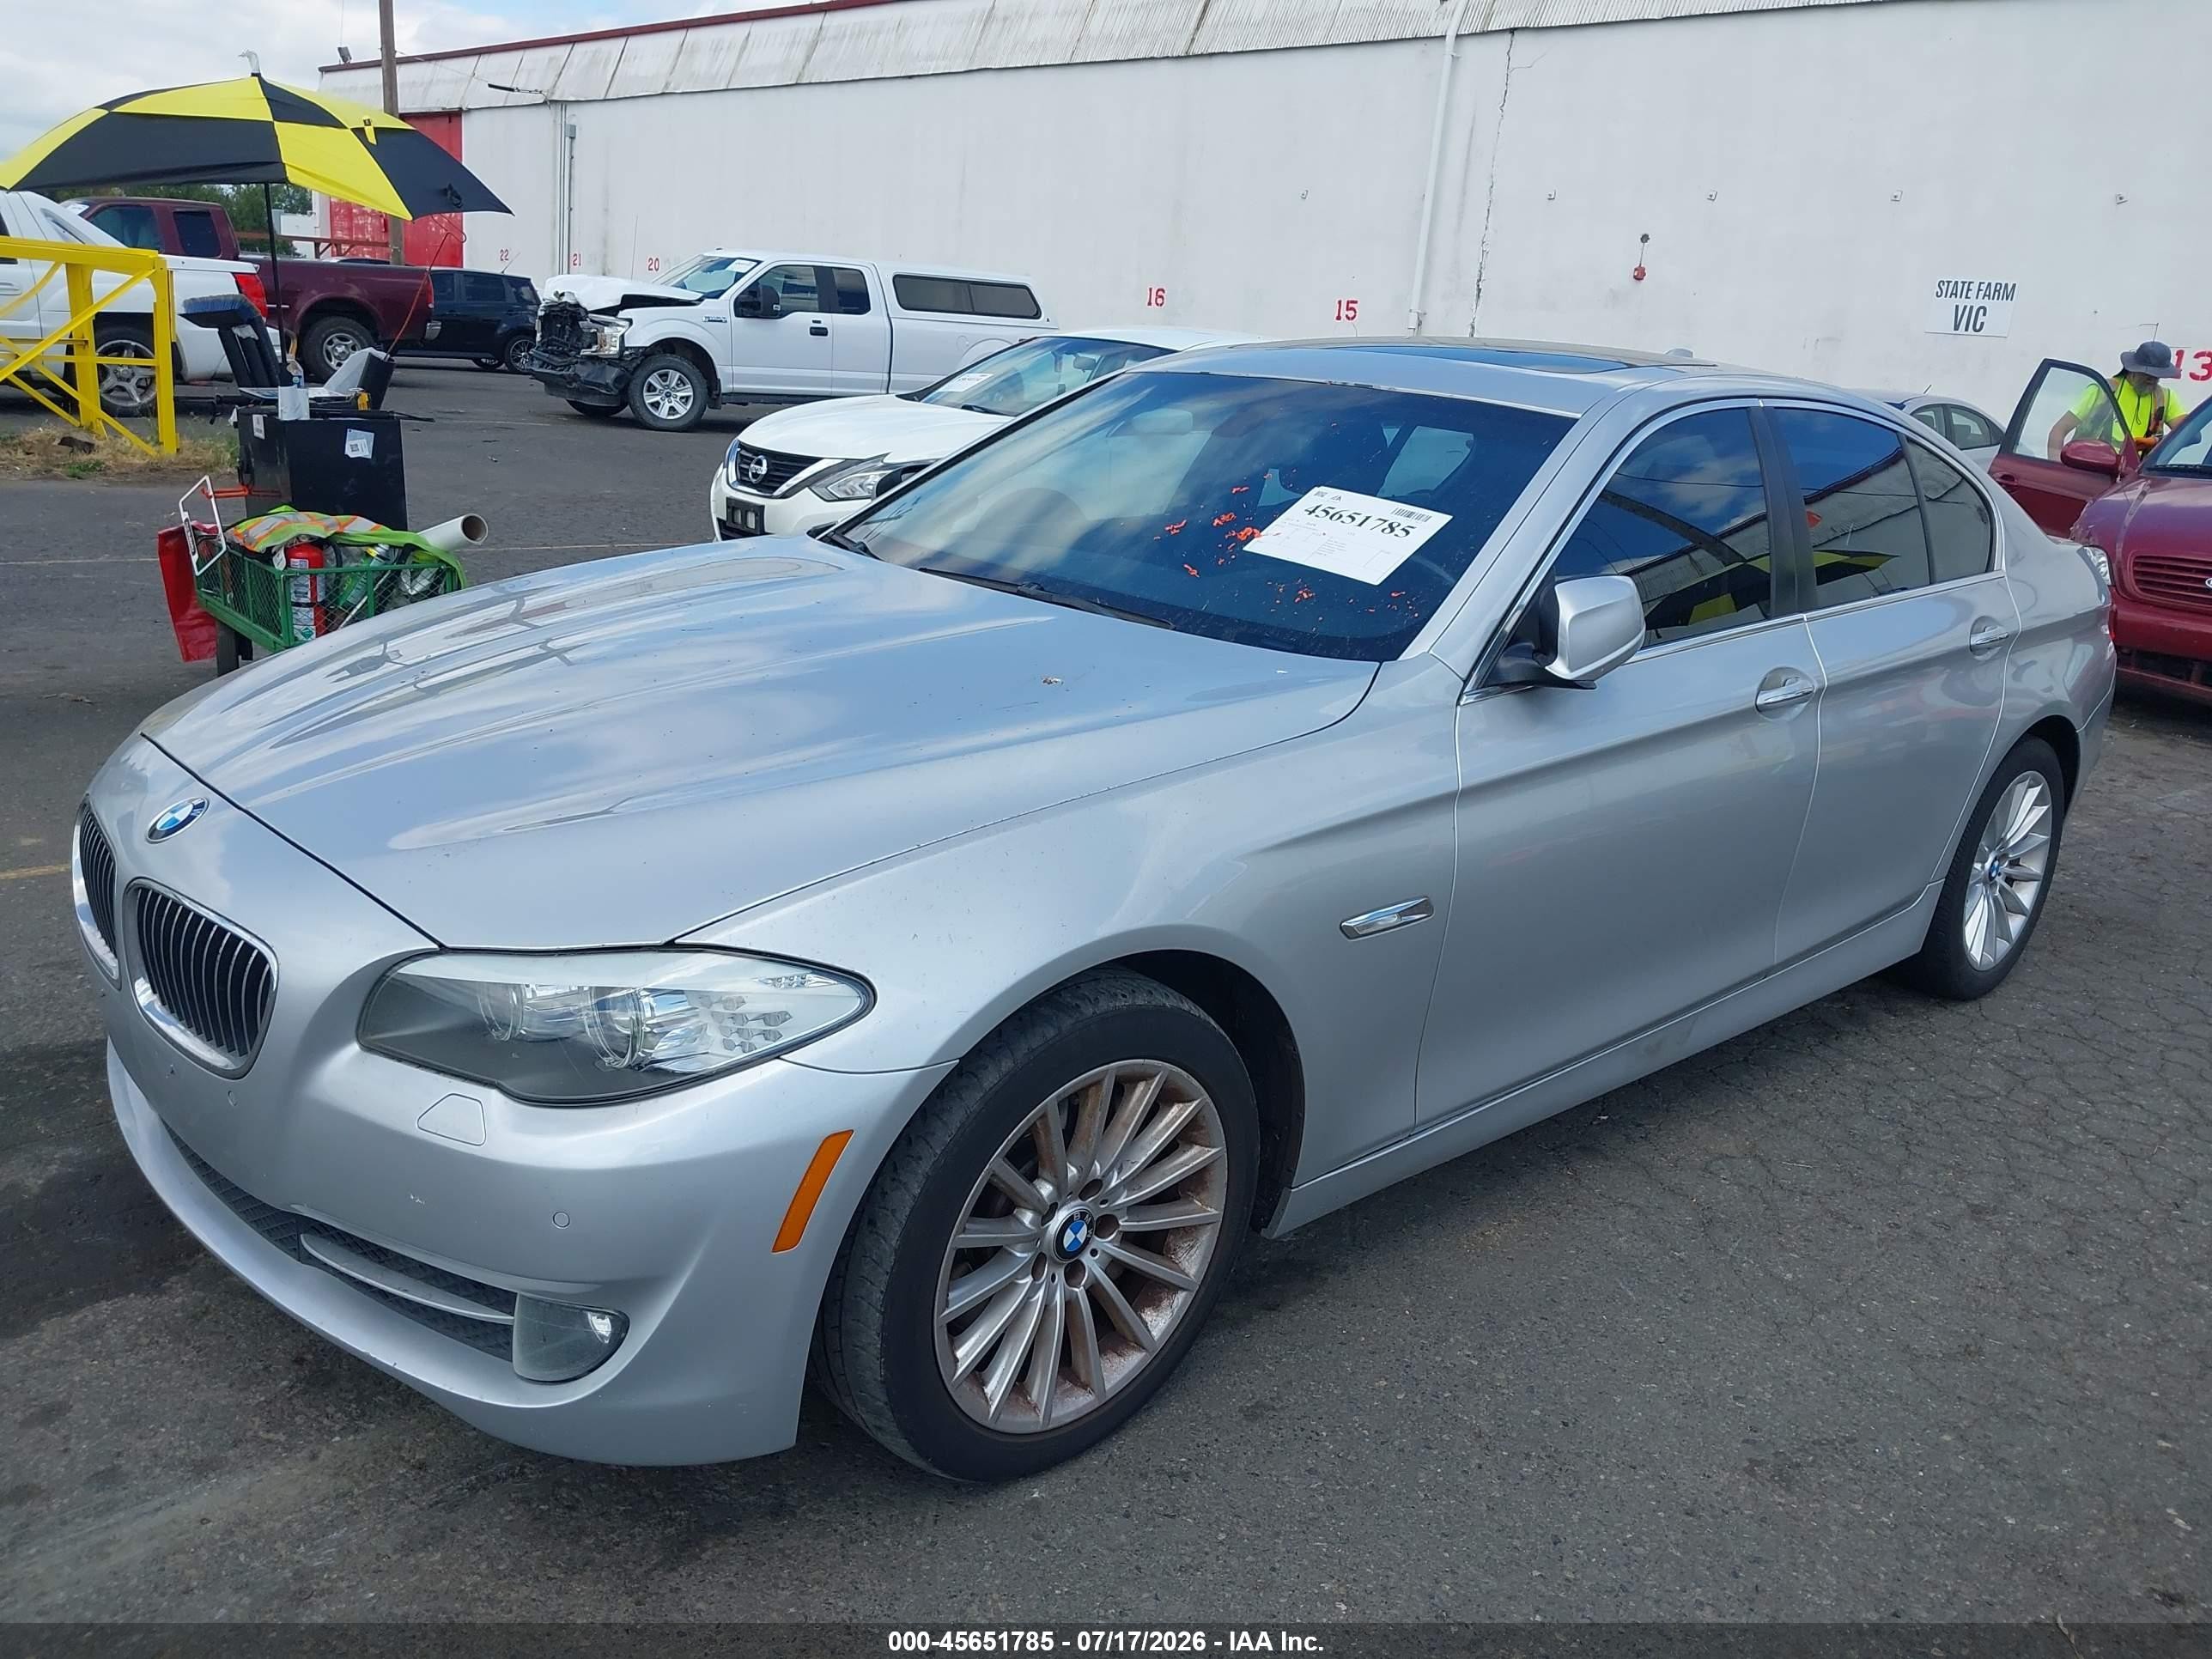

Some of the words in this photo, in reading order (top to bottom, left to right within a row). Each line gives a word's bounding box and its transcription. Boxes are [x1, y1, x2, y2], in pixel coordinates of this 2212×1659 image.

[499, 248, 510, 262] 22
[572, 253, 582, 267] 21
[647, 257, 660, 272] 20
[1146, 286, 1166, 307] 16
[1936, 279, 1974, 300] STATE
[1975, 281, 2017, 302] FARM
[1334, 299, 1359, 321] 15
[1952, 304, 1988, 333] VIC
[1304, 503, 1417, 539] 45651785
[1073, 1212, 1094, 1238] BMW
